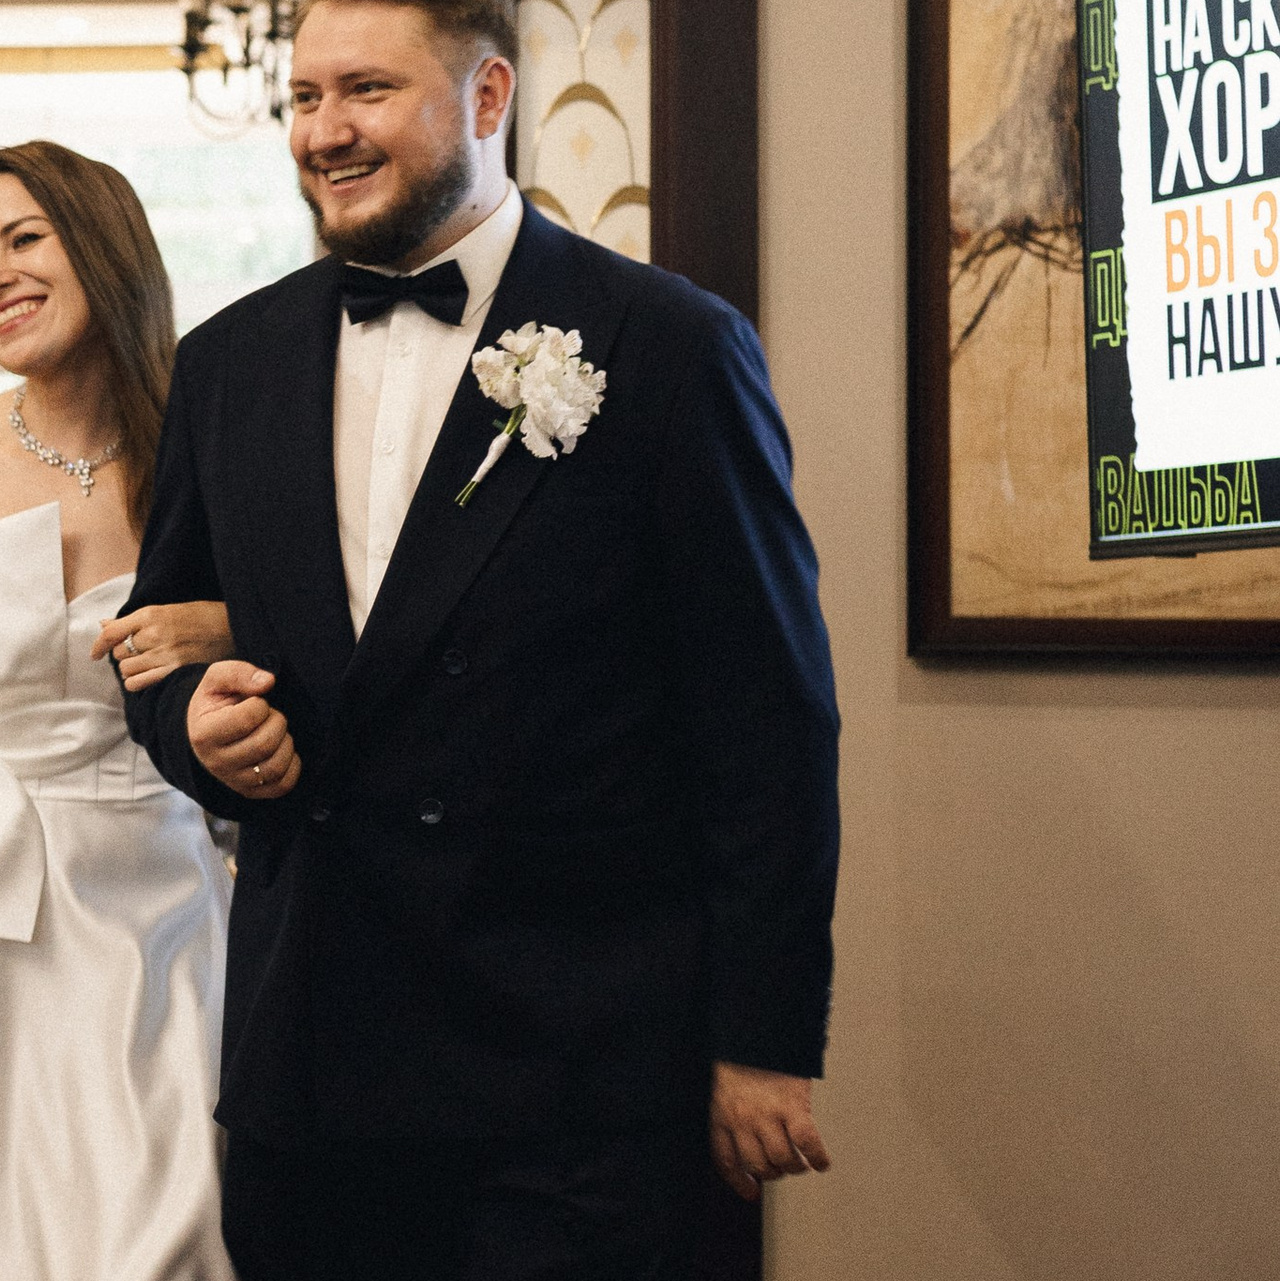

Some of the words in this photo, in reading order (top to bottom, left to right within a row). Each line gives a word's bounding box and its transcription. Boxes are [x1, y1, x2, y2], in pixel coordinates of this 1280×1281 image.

[1156, 50, 1280, 196] ХОР
[1165, 199, 1235, 293] ВЫ
[1097, 453, 1262, 537] ВАДЬБА
